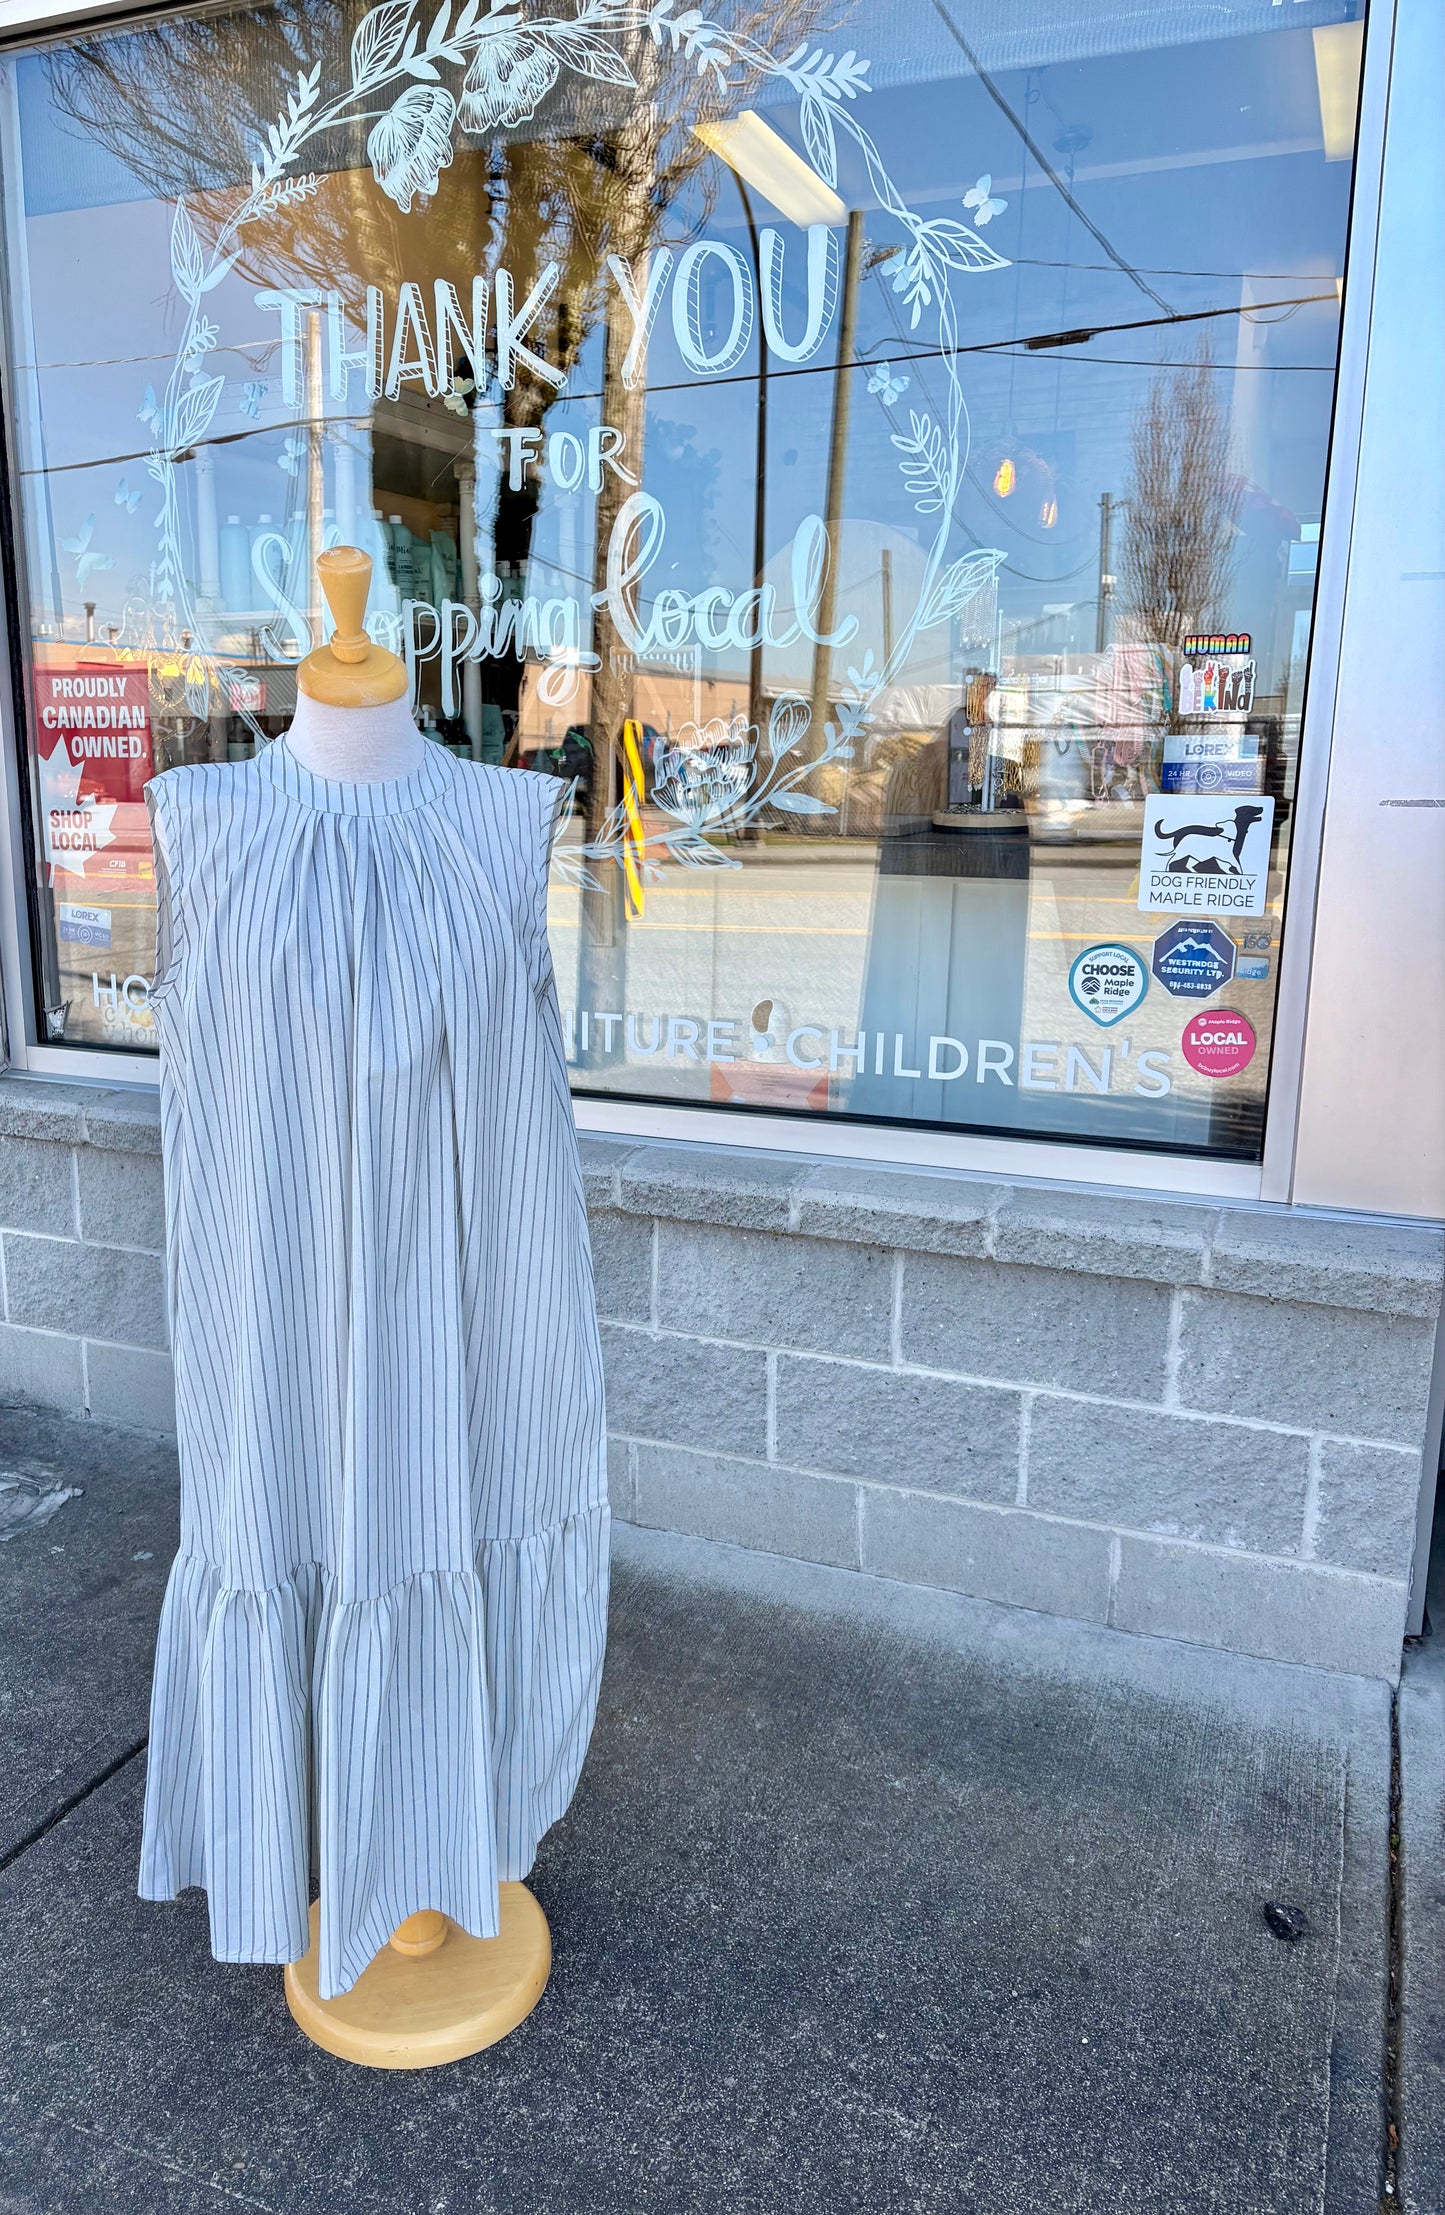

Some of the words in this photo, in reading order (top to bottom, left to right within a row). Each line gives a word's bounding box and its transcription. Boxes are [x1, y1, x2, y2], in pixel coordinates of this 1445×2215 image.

[255, 262, 568, 409] THANK
[606, 224, 840, 390] YOU
[491, 426, 641, 493] FOR
[590, 491, 859, 653] local
[1185, 633, 1250, 655] HUMAN
[52, 677, 127, 698] PROUDLY
[43, 705, 145, 729] CANADIAN
[71, 736, 147, 759] OWNED.
[1185, 743, 1235, 756] LOREX
[50, 810, 93, 830] SHOP
[51, 832, 100, 851] LOCAL
[109, 860, 126, 868] CFIB
[1150, 875, 1182, 888] DOG
[1186, 876, 1256, 891] FRIENDLY
[1149, 891, 1202, 905] MAPLE
[1207, 894, 1255, 908] RIDGE
[71, 908, 99, 922] LOREX
[1088, 951, 1113, 962] SUPPORT
[1113, 952, 1130, 963] LOCAL
[1168, 958, 1219, 969] WESTRIDGE
[1082, 964, 1136, 976] CHOOSE
[1160, 966, 1205, 976] SECURITY
[1104, 978, 1134, 988] Maple
[1104, 987, 1131, 996] Ridge
[1190, 1032, 1248, 1045] LOCAL
[1198, 1046, 1239, 1055] OWNED
[786, 1025, 1173, 1099] CHILDREN'S
